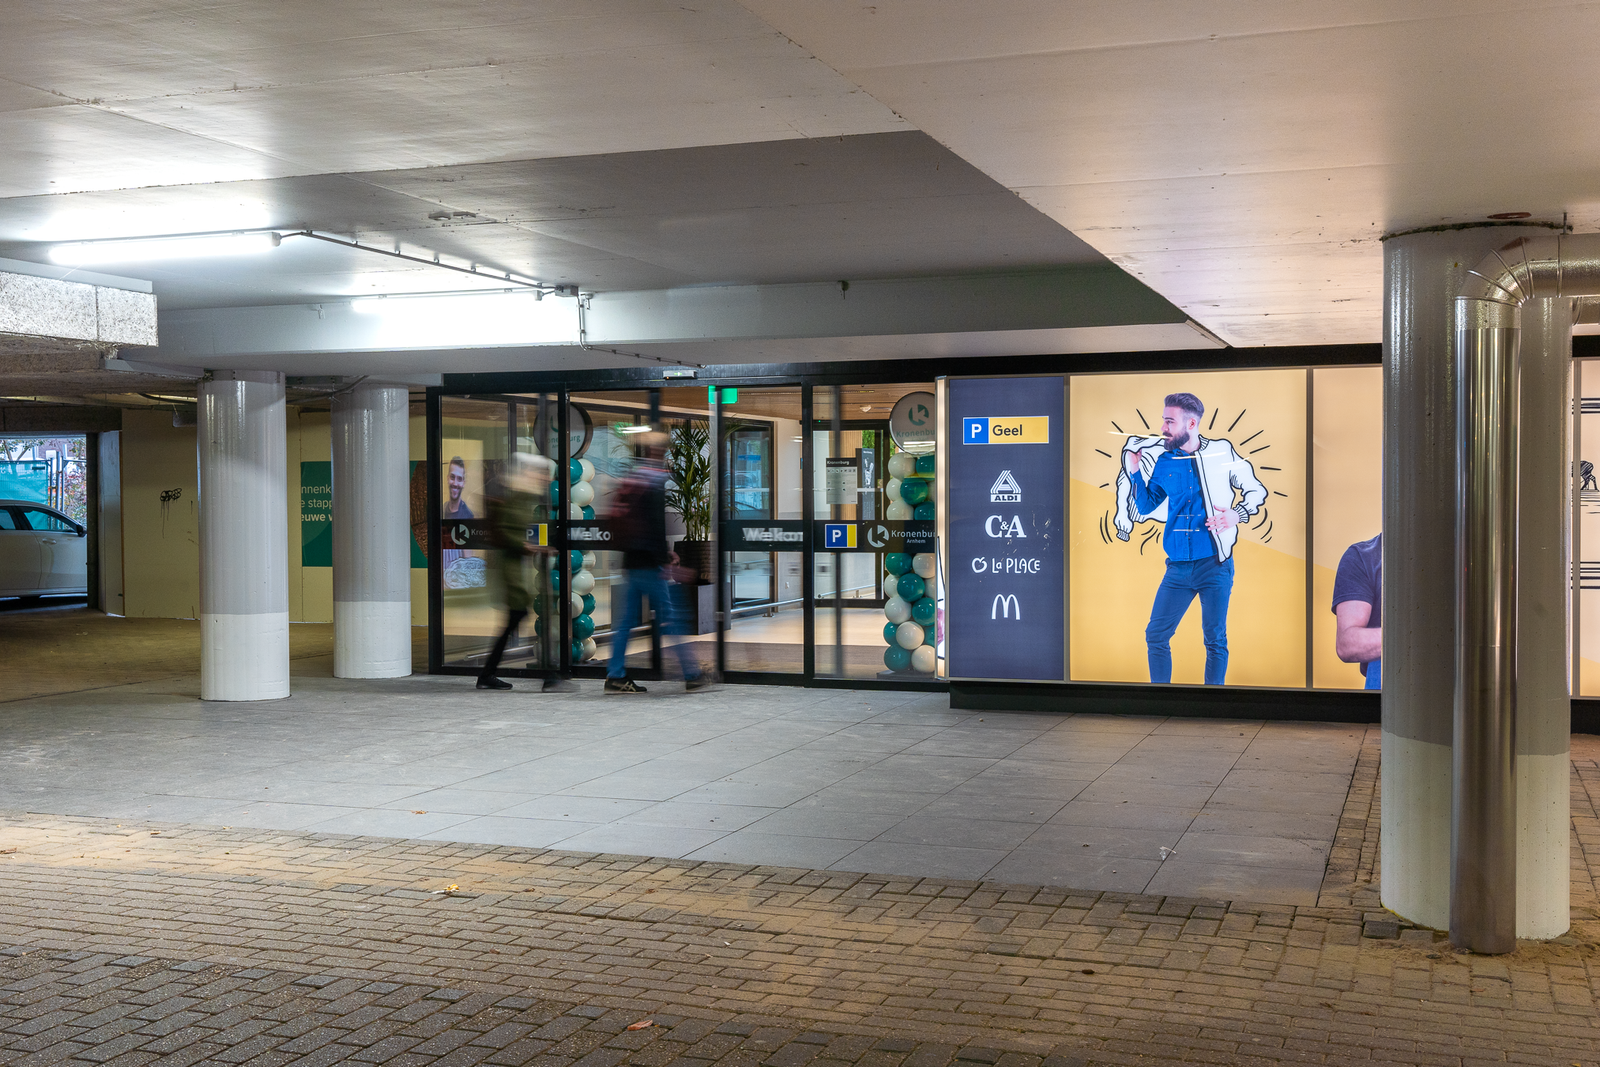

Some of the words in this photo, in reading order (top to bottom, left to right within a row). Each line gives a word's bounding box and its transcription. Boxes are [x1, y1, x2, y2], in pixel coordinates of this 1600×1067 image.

[971, 423, 982, 438] P
[992, 424, 1023, 436] Geel
[985, 515, 1027, 538] C&A
[832, 529, 842, 543] P
[1006, 558, 1041, 574] PLACE
